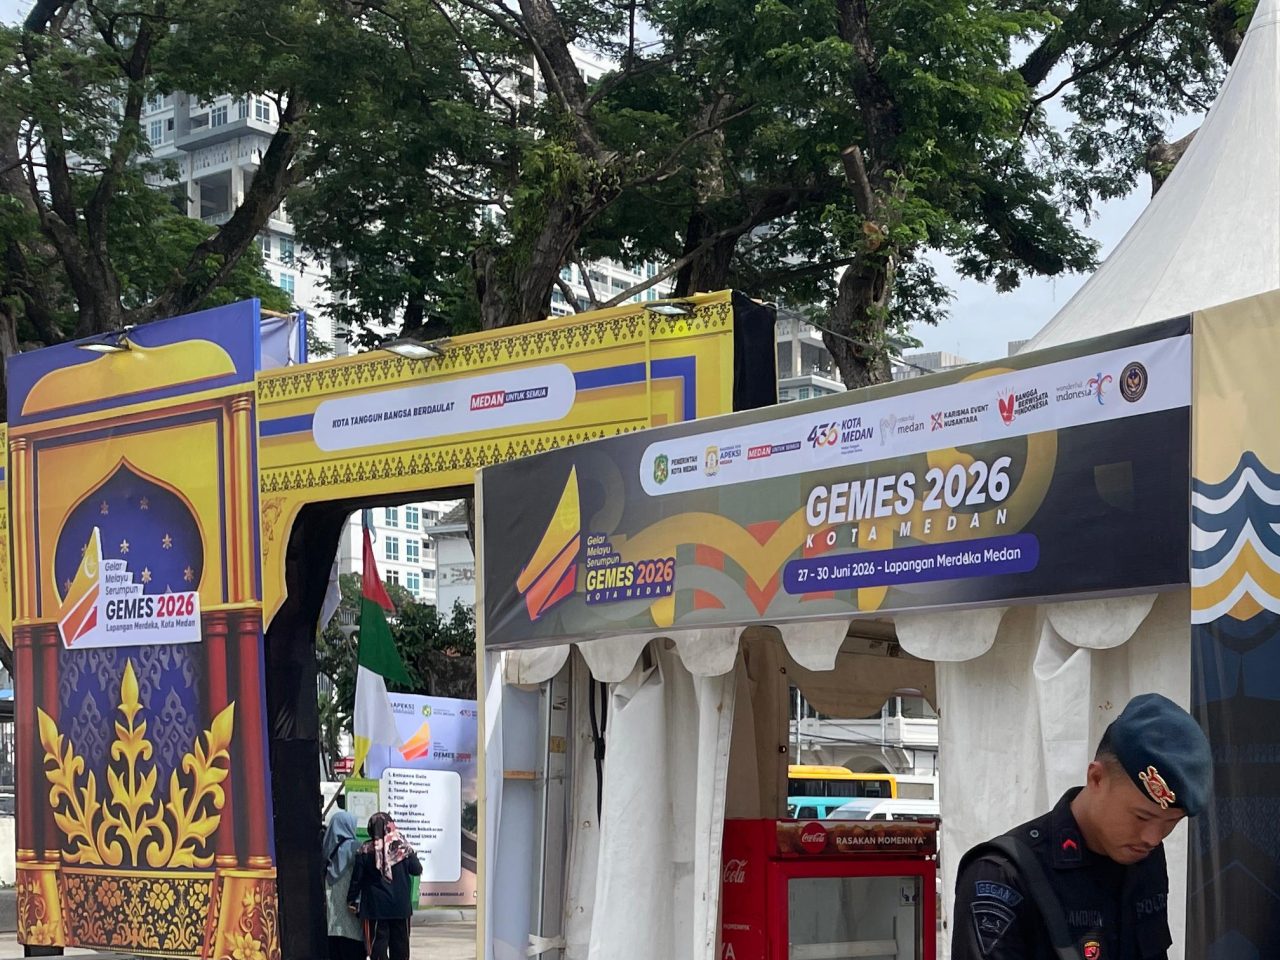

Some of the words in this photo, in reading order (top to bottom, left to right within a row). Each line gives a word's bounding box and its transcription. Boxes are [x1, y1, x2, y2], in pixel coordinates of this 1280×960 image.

[471, 394, 504, 408] MEDAN
[505, 393, 525, 402] UNTUK
[526, 388, 546, 400] SEMUA
[1015, 388, 1038, 402] BANGGA
[1018, 392, 1048, 408] BERWISATA
[332, 414, 349, 428] KOTA
[350, 412, 383, 426] TANGGUH
[384, 409, 412, 421] BANGSA
[413, 402, 455, 416] BERDAULAT
[944, 408, 969, 418] KARISMA
[970, 404, 989, 414] EVENT
[842, 417, 861, 431] KOTA
[944, 415, 978, 427] NUSANTARA
[898, 422, 925, 434] medan
[841, 427, 873, 443] MEDAN
[720, 450, 741, 459] APEKSI
[749, 446, 771, 458] MEDAN
[806, 472, 916, 527] GEMES
[922, 456, 1012, 512] 2026
[806, 525, 877, 549] KOTA
[900, 508, 1008, 538] MEDAN
[587, 535, 605, 546] Gelar
[587, 546, 611, 556] Melayu
[105, 562, 122, 571] Gelar
[587, 556, 619, 568] Serumpun
[798, 569, 808, 581] 27
[817, 567, 829, 580] 30
[831, 565, 850, 579] Juni
[852, 563, 875, 577] 2026
[885, 559, 934, 576] Lapangan
[984, 547, 1021, 562] Medan
[105, 574, 128, 584] Melayu
[586, 565, 634, 591] GEMES
[636, 561, 674, 585] 2026
[105, 586, 138, 597] Serumpun
[586, 591, 617, 602] KOTA
[626, 585, 672, 596] MEDAN
[106, 597, 154, 620] GEMES
[156, 593, 194, 618] 2026
[106, 624, 133, 632] Lapangan
[134, 621, 159, 630] Merdeka,
[160, 620, 174, 629] Kota
[176, 619, 195, 627] Medan
[801, 832, 825, 844] Coca-Cola
[836, 837, 876, 845] RASAKAN
